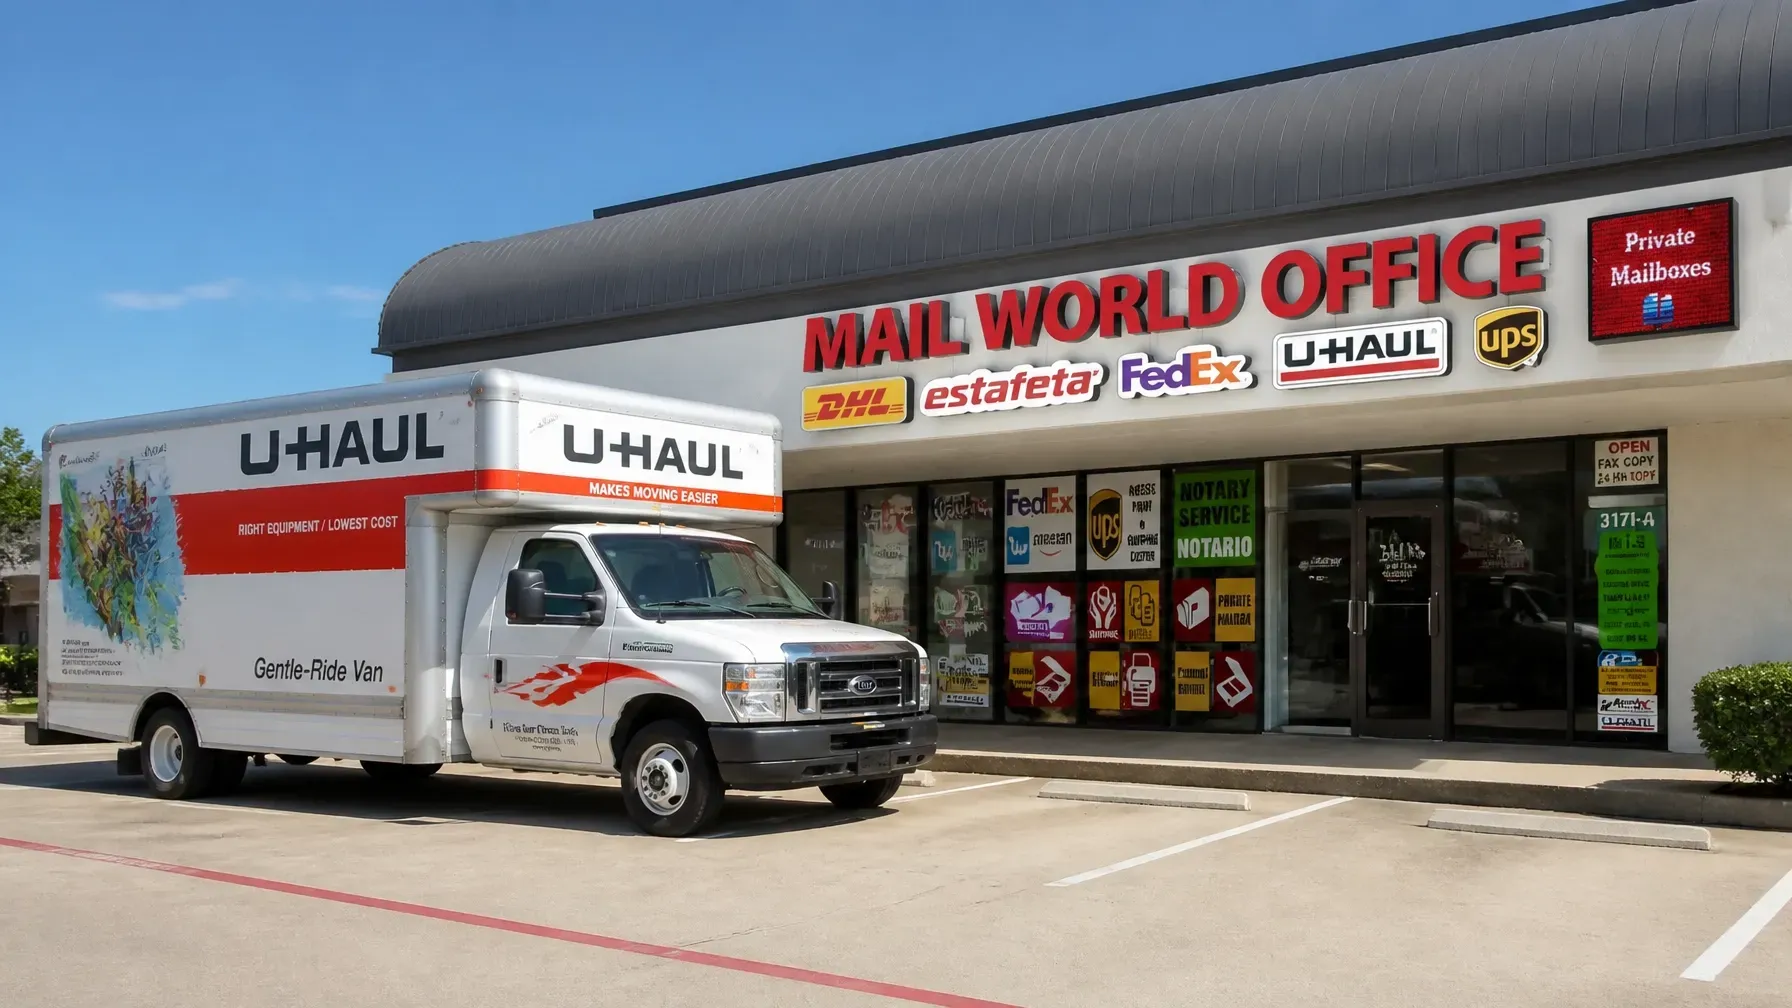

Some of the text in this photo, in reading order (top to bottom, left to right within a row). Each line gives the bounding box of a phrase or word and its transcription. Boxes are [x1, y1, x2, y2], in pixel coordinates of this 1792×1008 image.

[1625, 228, 1696, 252] Private
[1610, 261, 1712, 287] Mailboxes
[803, 218, 1546, 372] MAIL WORLD OFFICE
[1284, 329, 1436, 368] U-HAUL
[1480, 324, 1537, 358] ups
[1122, 350, 1241, 393] FedEx
[924, 368, 1094, 410] estafeta
[816, 387, 890, 421] DHL
[240, 412, 444, 476] U-HAUL
[563, 423, 744, 480] U-HAUL
[1608, 440, 1650, 454] OPEN
[1598, 455, 1655, 469] FAX COPY
[589, 482, 719, 505] MAKES MOVING EASIER
[1006, 487, 1074, 516] FedEx
[1180, 478, 1250, 502] NOTARY
[238, 523, 265, 536] RIGHT
[267, 519, 320, 536] EQUIPMENT
[328, 516, 369, 531] LOWEST
[370, 515, 398, 528] COST
[1179, 504, 1250, 527] SERVICE
[1600, 511, 1655, 528] 3171-A
[1177, 535, 1253, 559] NOTARIO
[254, 657, 383, 682] Gentle-Ride Van
